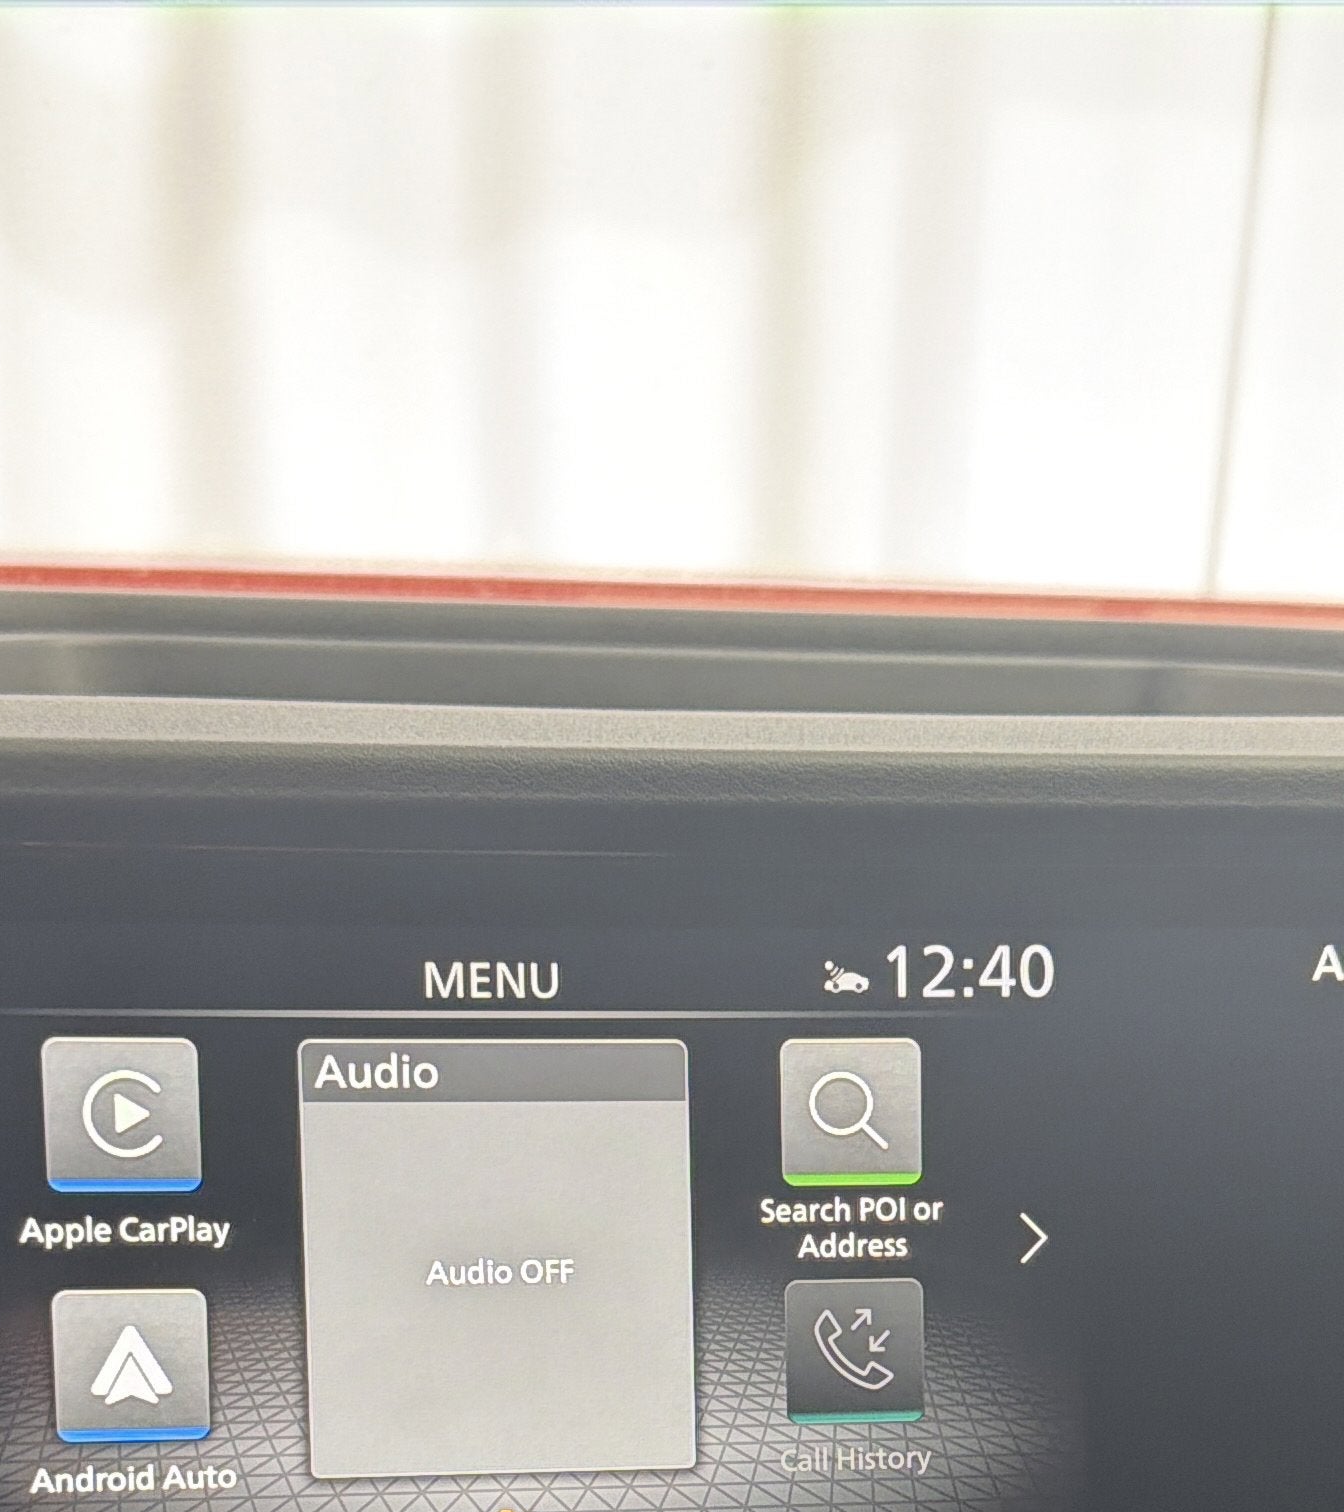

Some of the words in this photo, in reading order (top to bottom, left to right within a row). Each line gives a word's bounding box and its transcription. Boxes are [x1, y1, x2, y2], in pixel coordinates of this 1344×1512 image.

[424, 961, 560, 999] MENU
[886, 944, 1055, 999] 12:40
[314, 1053, 440, 1090] Audio
[760, 1197, 851, 1225] Search
[858, 1197, 906, 1222] POI
[913, 1203, 943, 1222] or
[19, 1217, 112, 1249] Apple
[119, 1217, 230, 1248] CarPlay
[797, 1232, 908, 1260] Address
[426, 1259, 513, 1286] Audio
[520, 1259, 575, 1284] OFF
[780, 1447, 829, 1473] Call
[836, 1446, 933, 1476] History
[30, 1465, 155, 1495] Android
[162, 1464, 237, 1490] Auto
